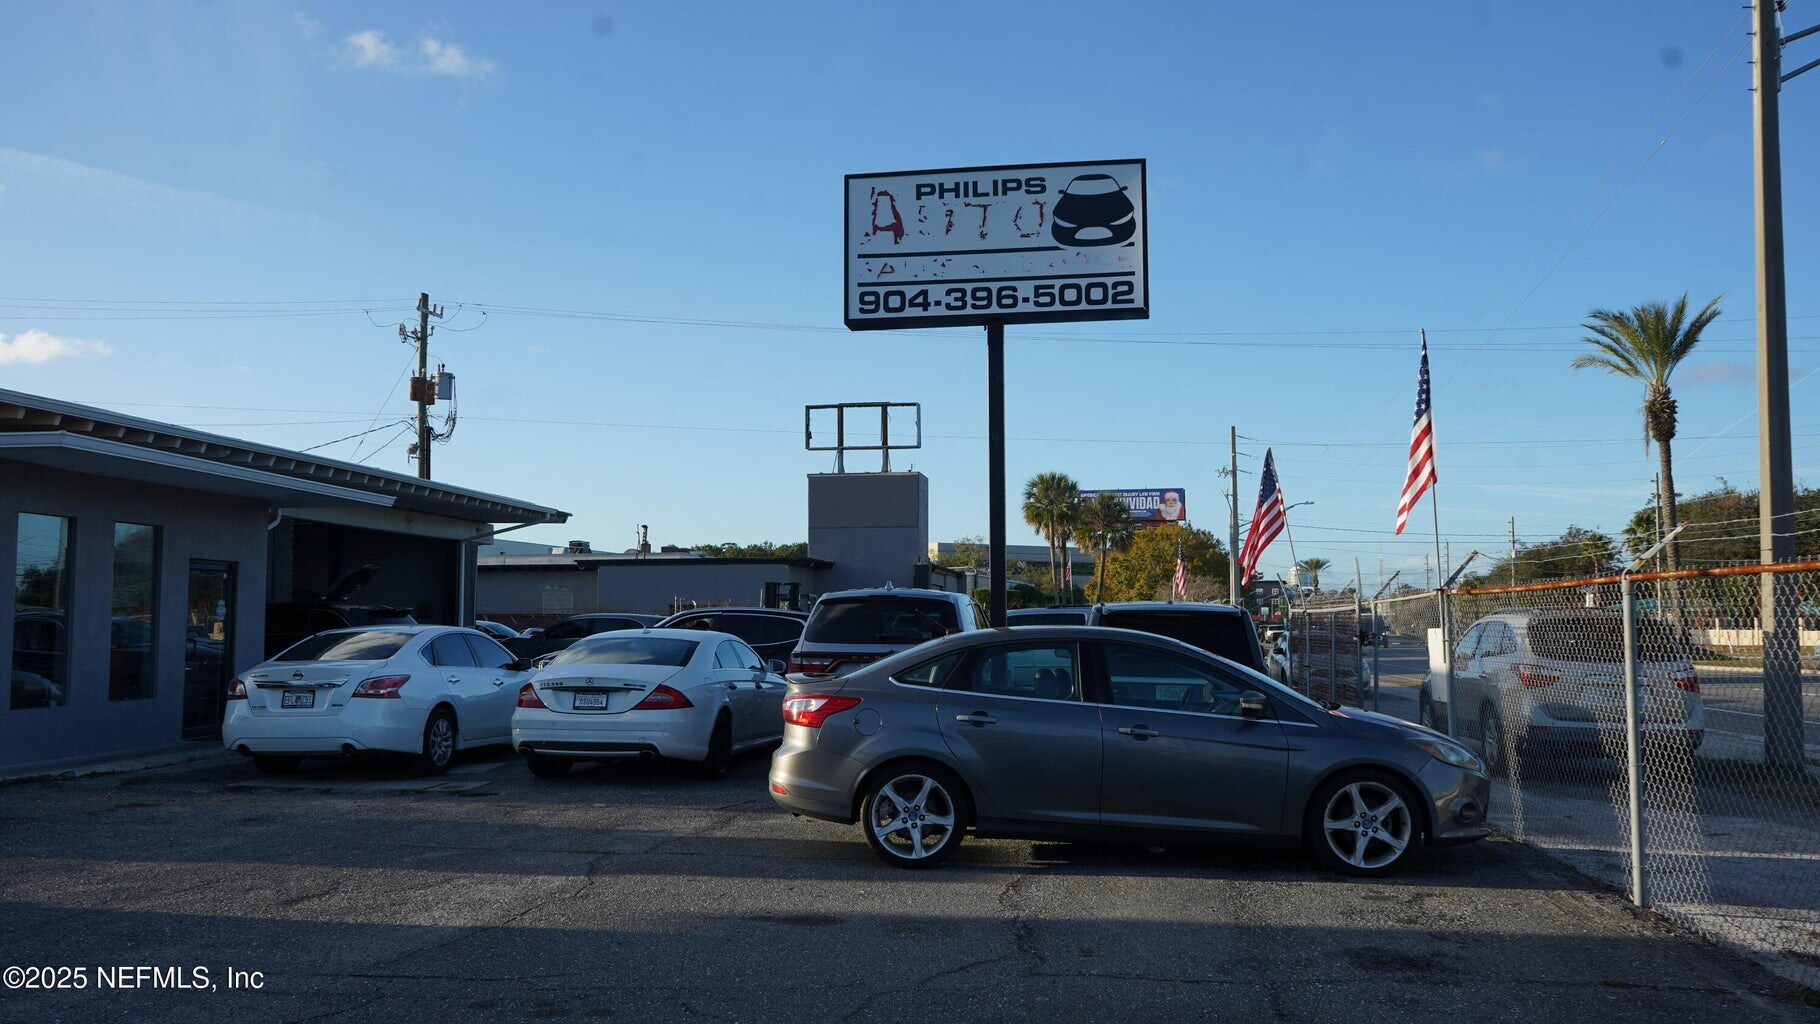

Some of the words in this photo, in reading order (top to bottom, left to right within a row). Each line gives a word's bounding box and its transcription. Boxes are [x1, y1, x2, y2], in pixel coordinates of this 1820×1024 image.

[915, 176, 1047, 200] PHILIPS
[861, 187, 1047, 246] ATO
[858, 280, 1136, 315] 904-396-5002
[1115, 496, 1160, 510] VIDAD
